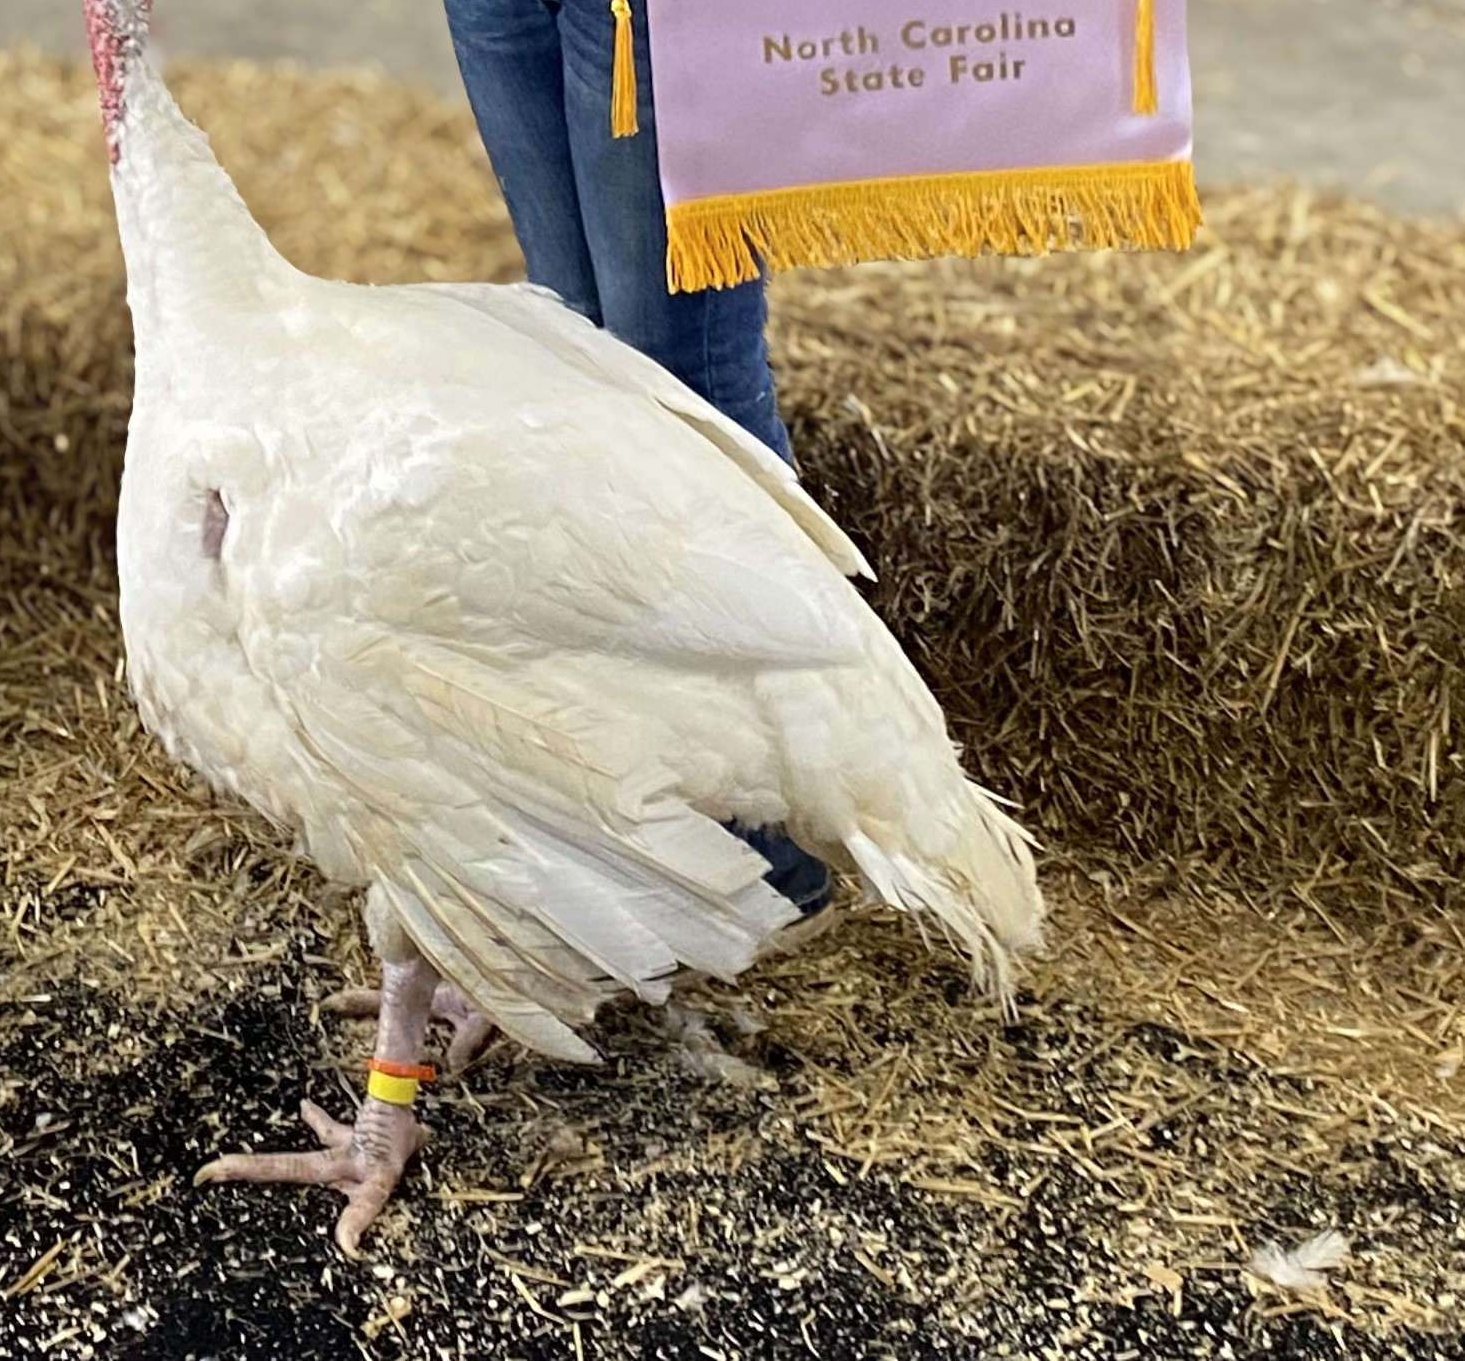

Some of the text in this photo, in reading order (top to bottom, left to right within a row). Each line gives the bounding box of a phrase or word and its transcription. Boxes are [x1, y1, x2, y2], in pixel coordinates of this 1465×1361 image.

[763, 12, 1077, 64] North Carolina
[820, 52, 1027, 97] State Fair
